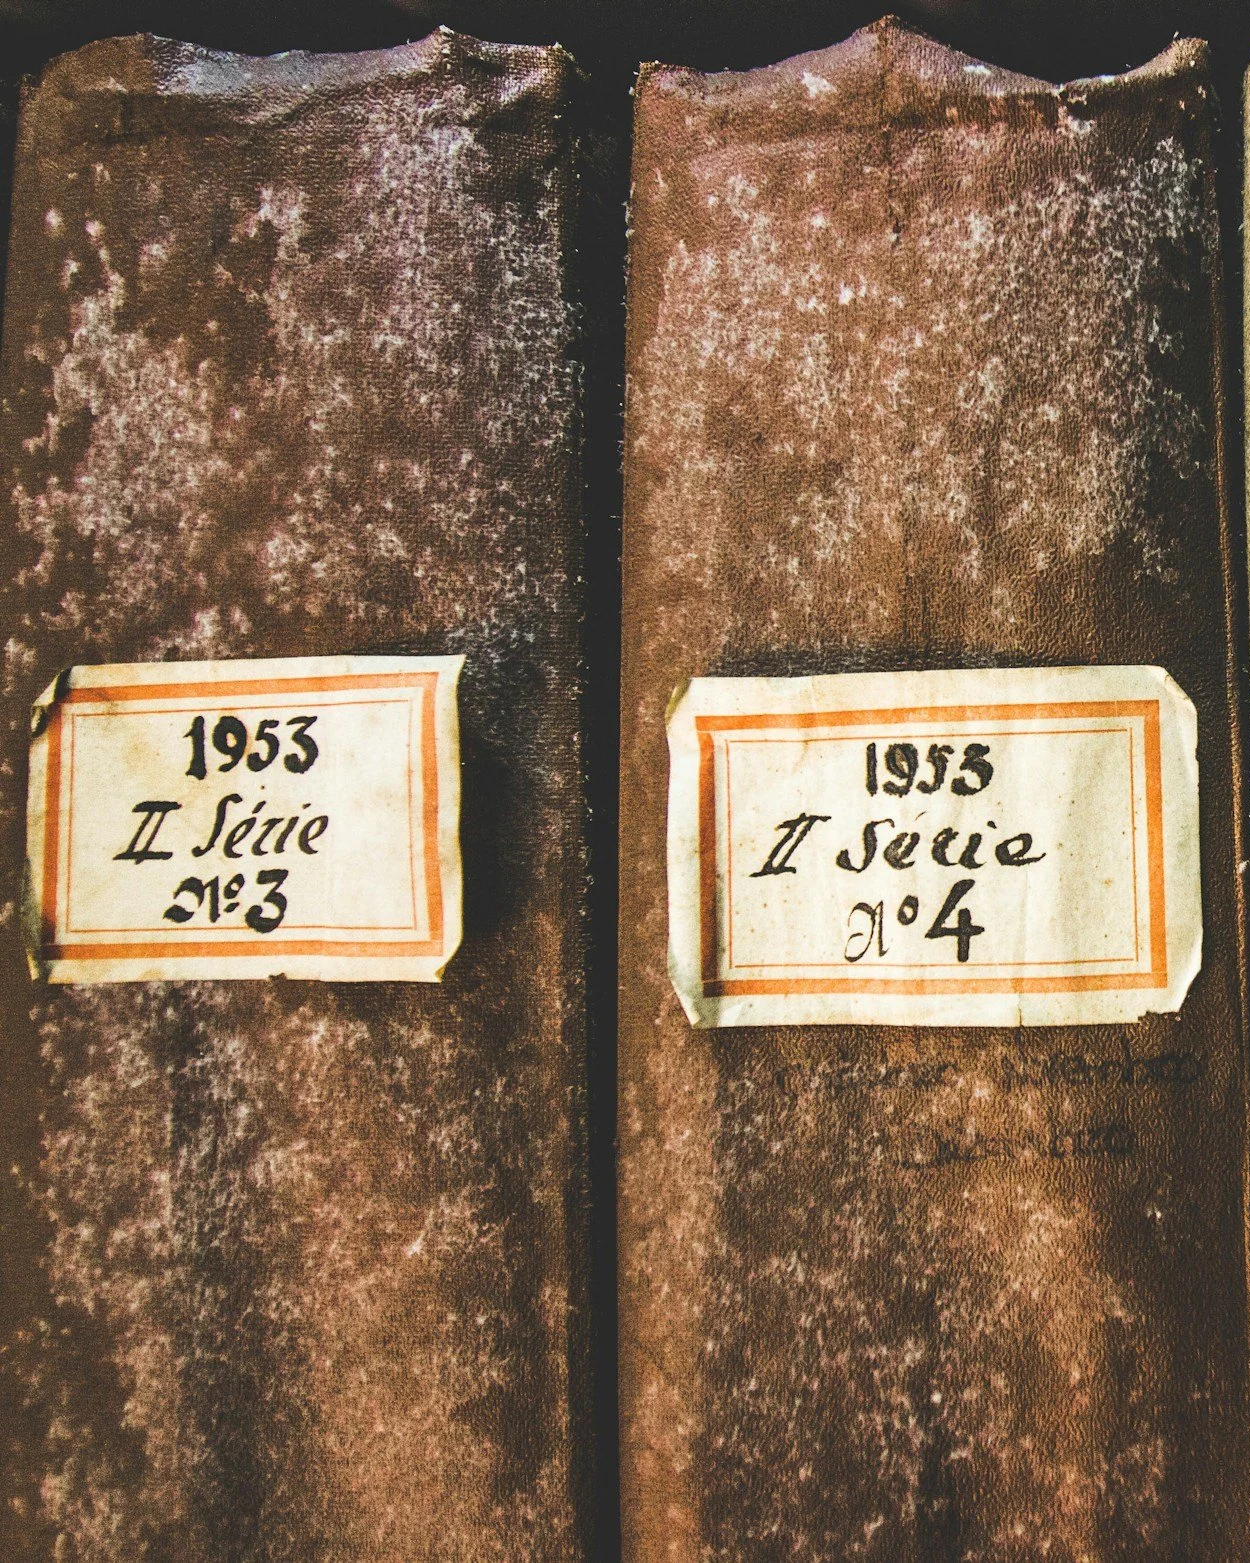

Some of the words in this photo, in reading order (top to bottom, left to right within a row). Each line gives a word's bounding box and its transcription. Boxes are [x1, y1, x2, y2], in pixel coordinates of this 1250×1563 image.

[183, 715, 319, 780] 1953
[112, 799, 183, 865] II
[191, 793, 329, 859] Série
[749, 813, 832, 878] II
